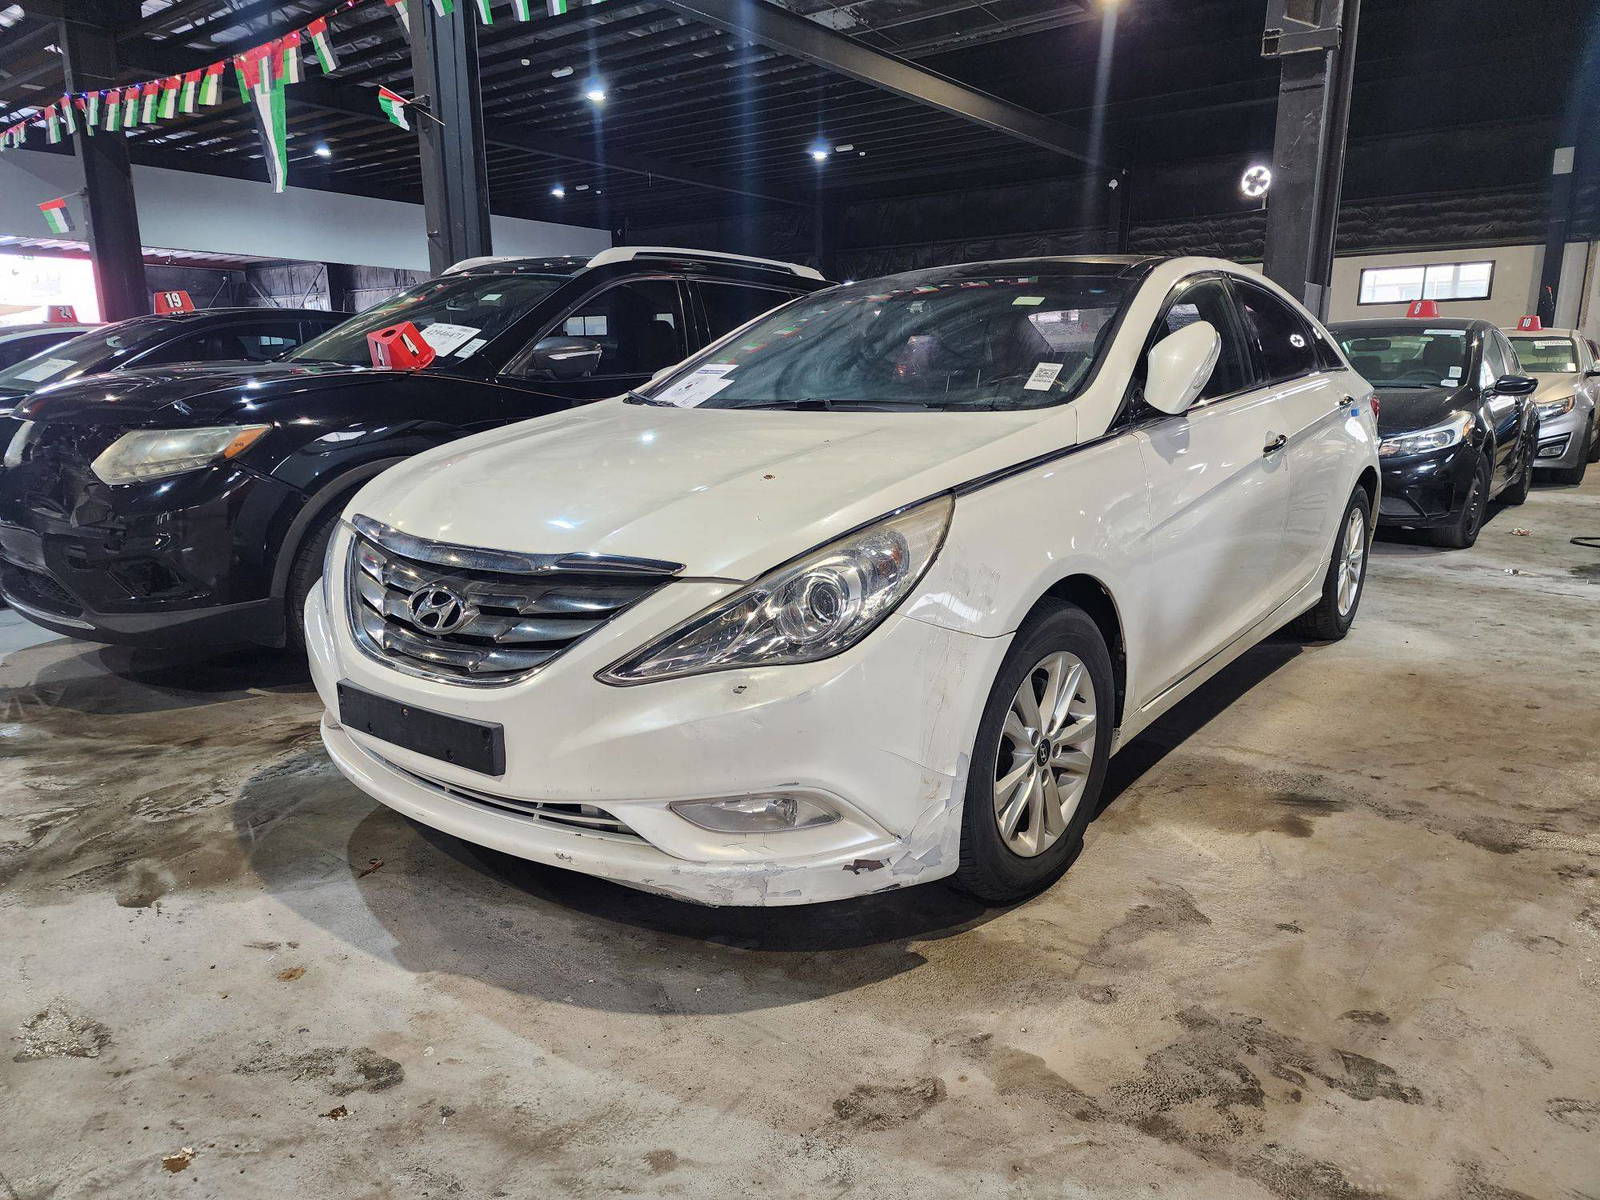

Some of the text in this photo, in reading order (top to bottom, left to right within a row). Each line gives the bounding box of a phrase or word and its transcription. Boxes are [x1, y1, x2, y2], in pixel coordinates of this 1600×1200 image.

[165, 292, 183, 308] 19
[1522, 317, 1532, 328] 10
[402, 333, 420, 356] 4
